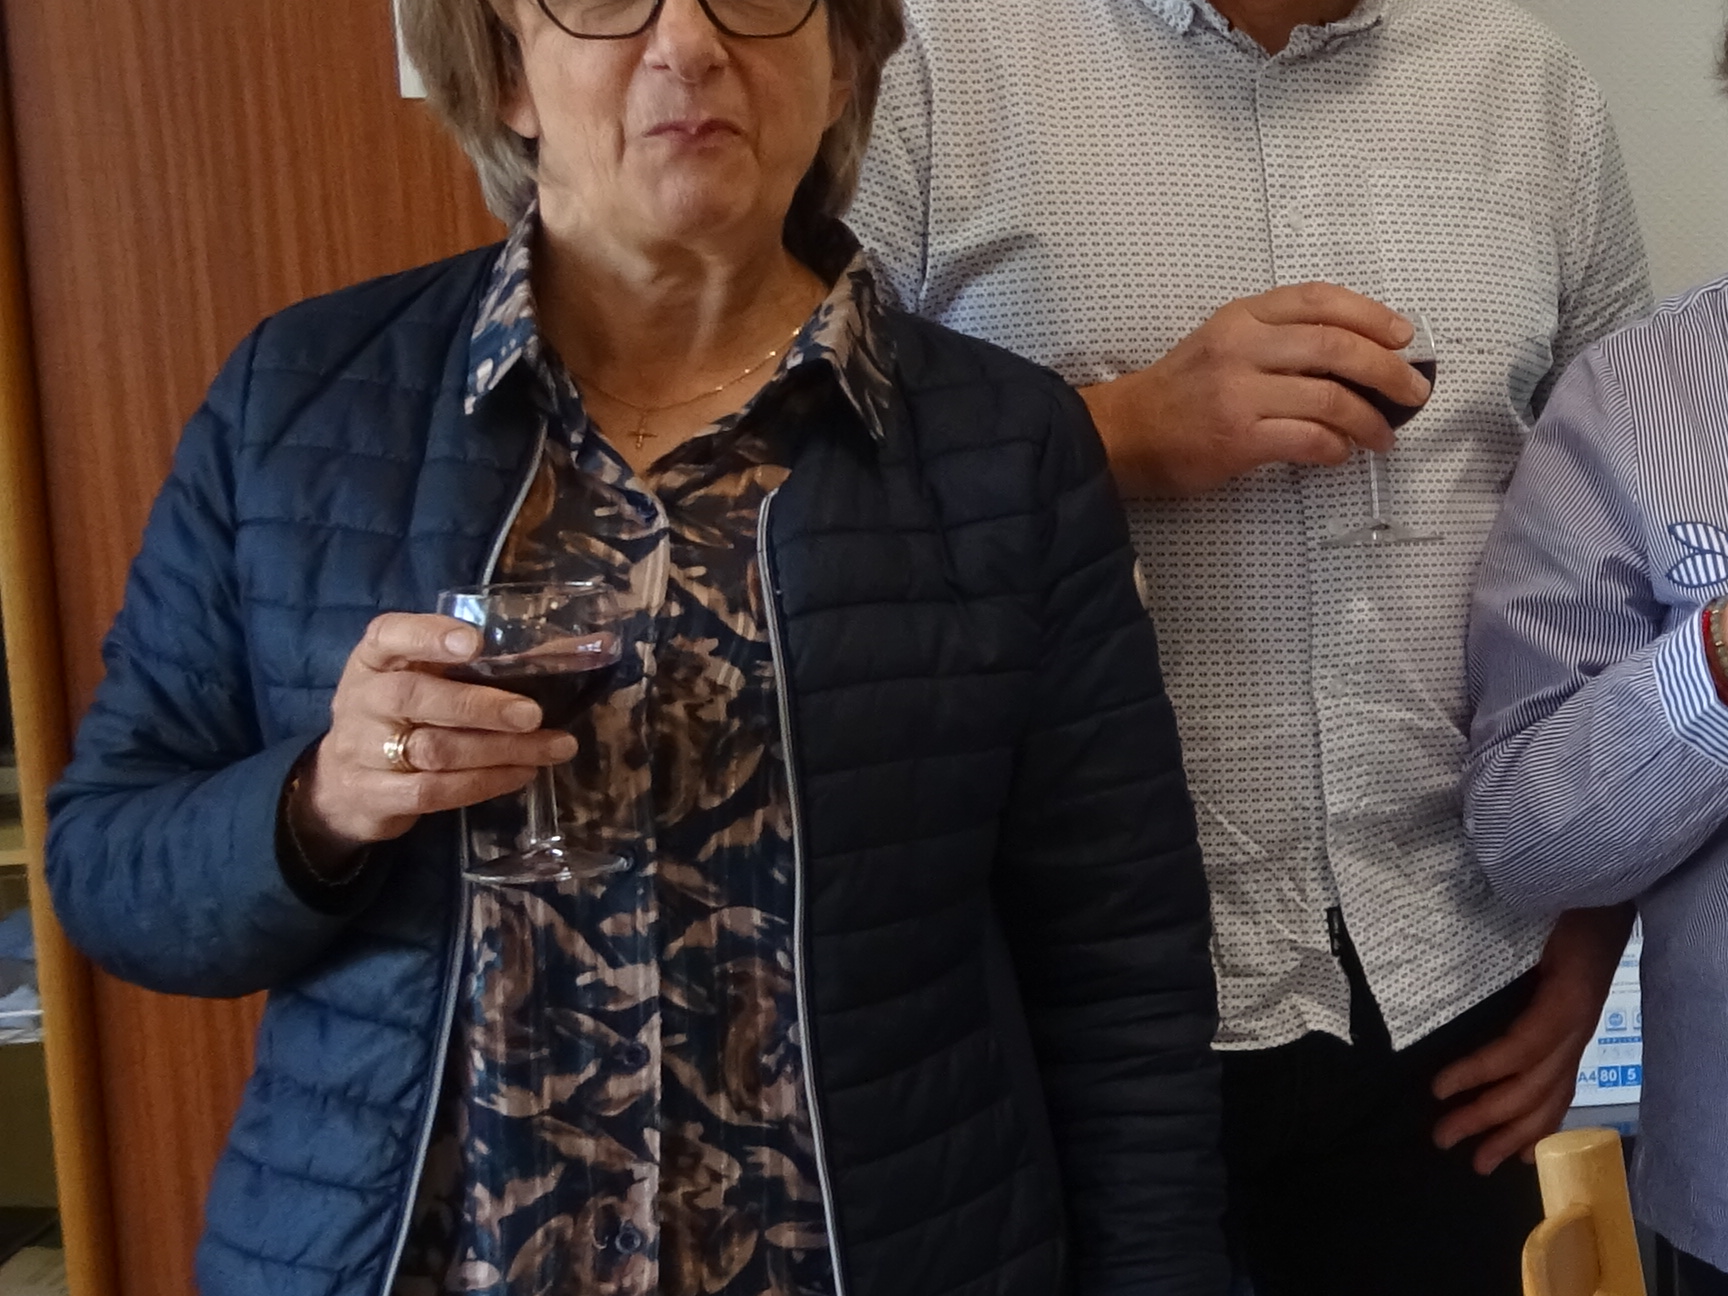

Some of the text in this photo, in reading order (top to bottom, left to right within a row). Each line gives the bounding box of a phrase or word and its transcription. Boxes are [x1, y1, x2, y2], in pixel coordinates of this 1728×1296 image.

[1578, 1068, 1636, 1082] A4 80 5
